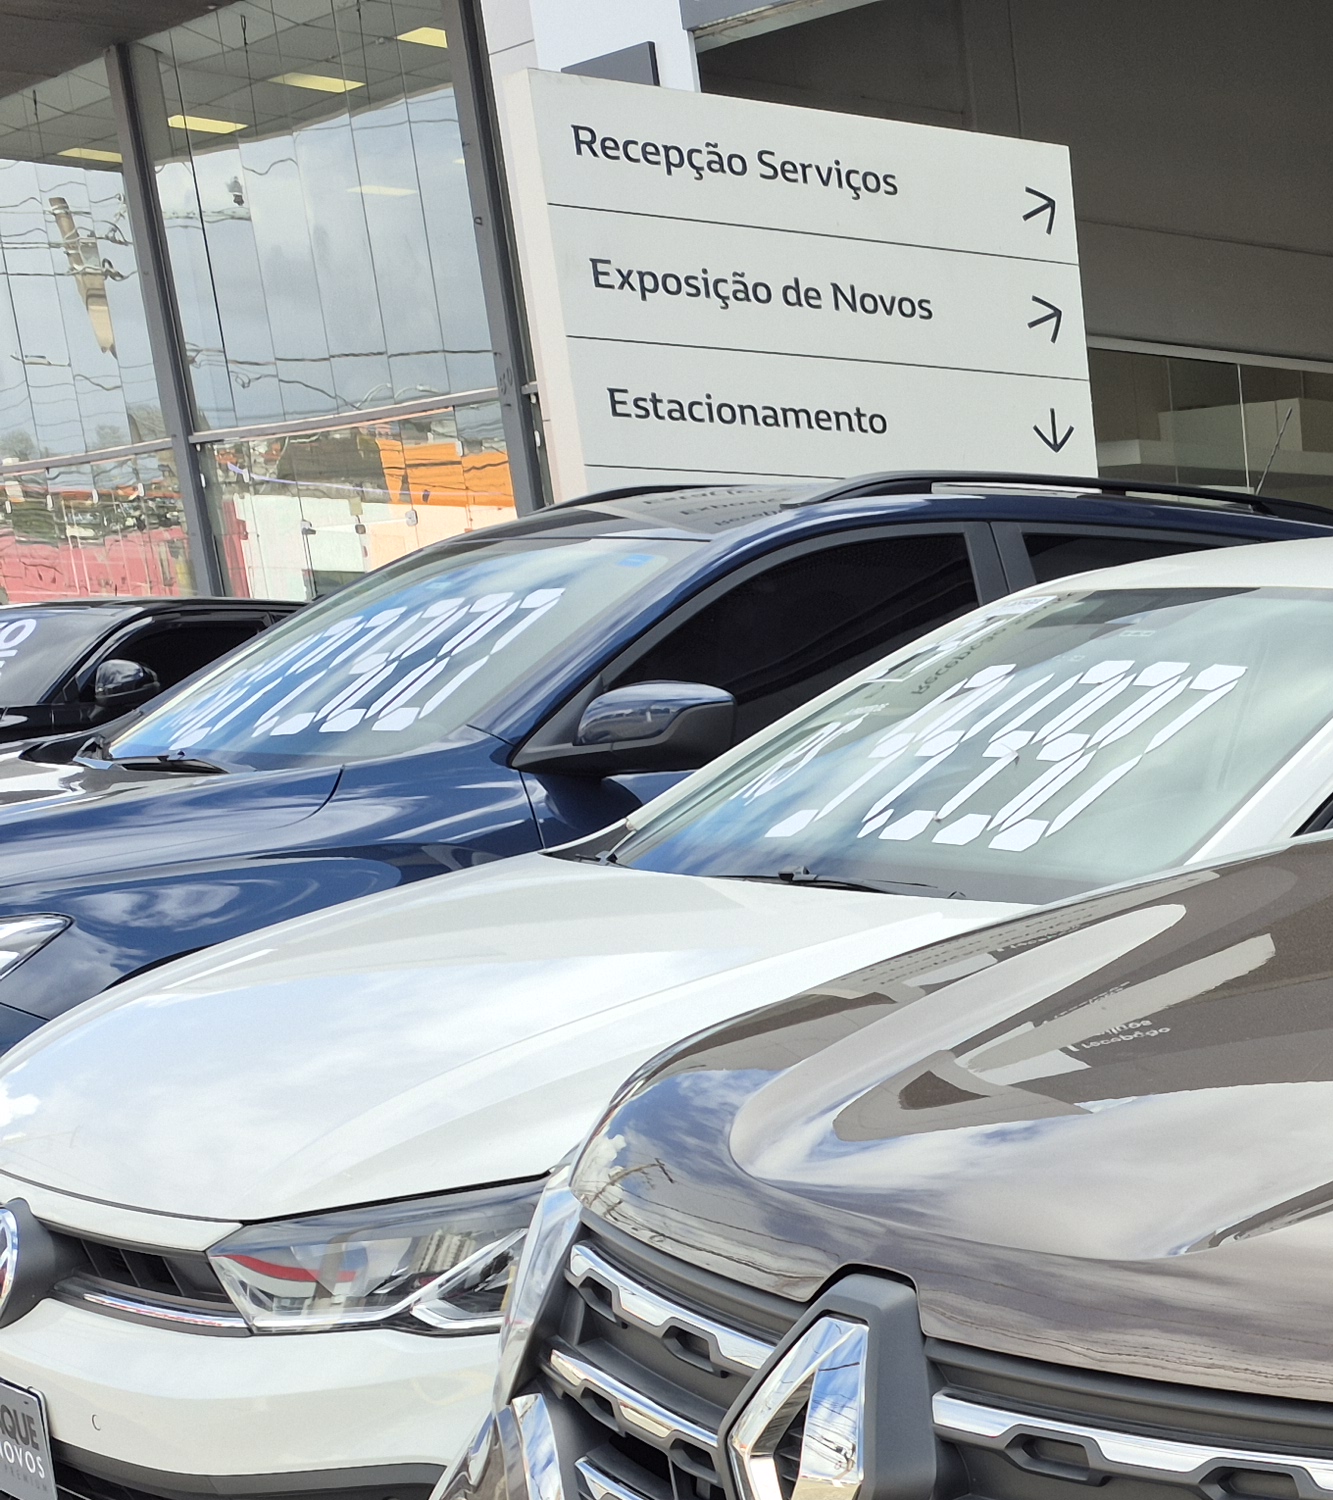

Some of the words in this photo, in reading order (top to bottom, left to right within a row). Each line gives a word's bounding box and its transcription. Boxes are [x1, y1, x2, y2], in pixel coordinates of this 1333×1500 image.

[571, 124, 749, 181] Recepção
[756, 149, 899, 199] Serviços
[589, 257, 773, 310] Exposição
[781, 277, 823, 310] de
[831, 282, 934, 320] Novos
[606, 386, 888, 435] Estacionamento
